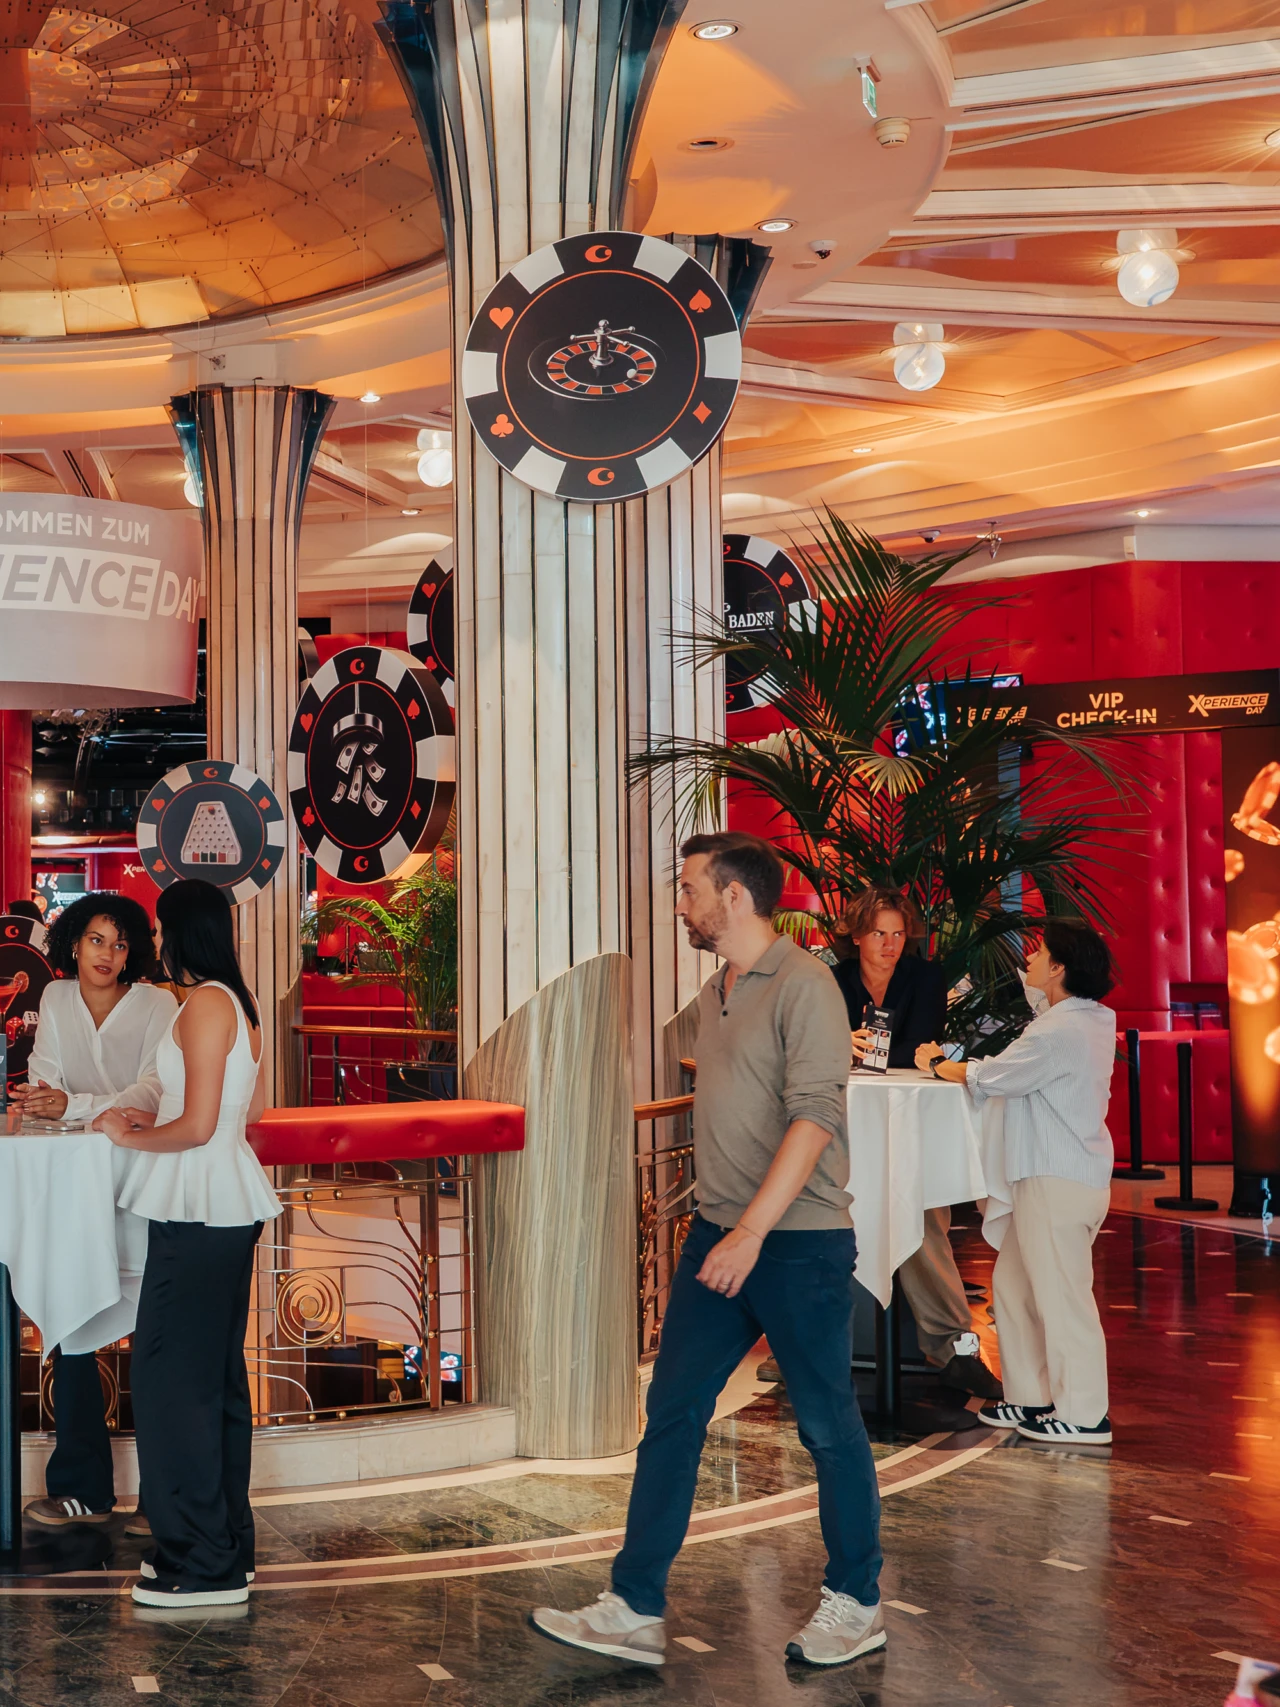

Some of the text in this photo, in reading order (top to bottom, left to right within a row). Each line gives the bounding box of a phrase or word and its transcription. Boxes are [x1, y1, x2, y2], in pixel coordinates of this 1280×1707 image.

[102, 517, 150, 546] ZUM
[157, 570, 200, 623] DAY
[728, 611, 775, 629] BADEN
[1089, 692, 1124, 709] VIP
[1188, 694, 1269, 717] XPERIENCE
[1246, 706, 1265, 715] DAY
[1056, 708, 1157, 728] CHECK-IN
